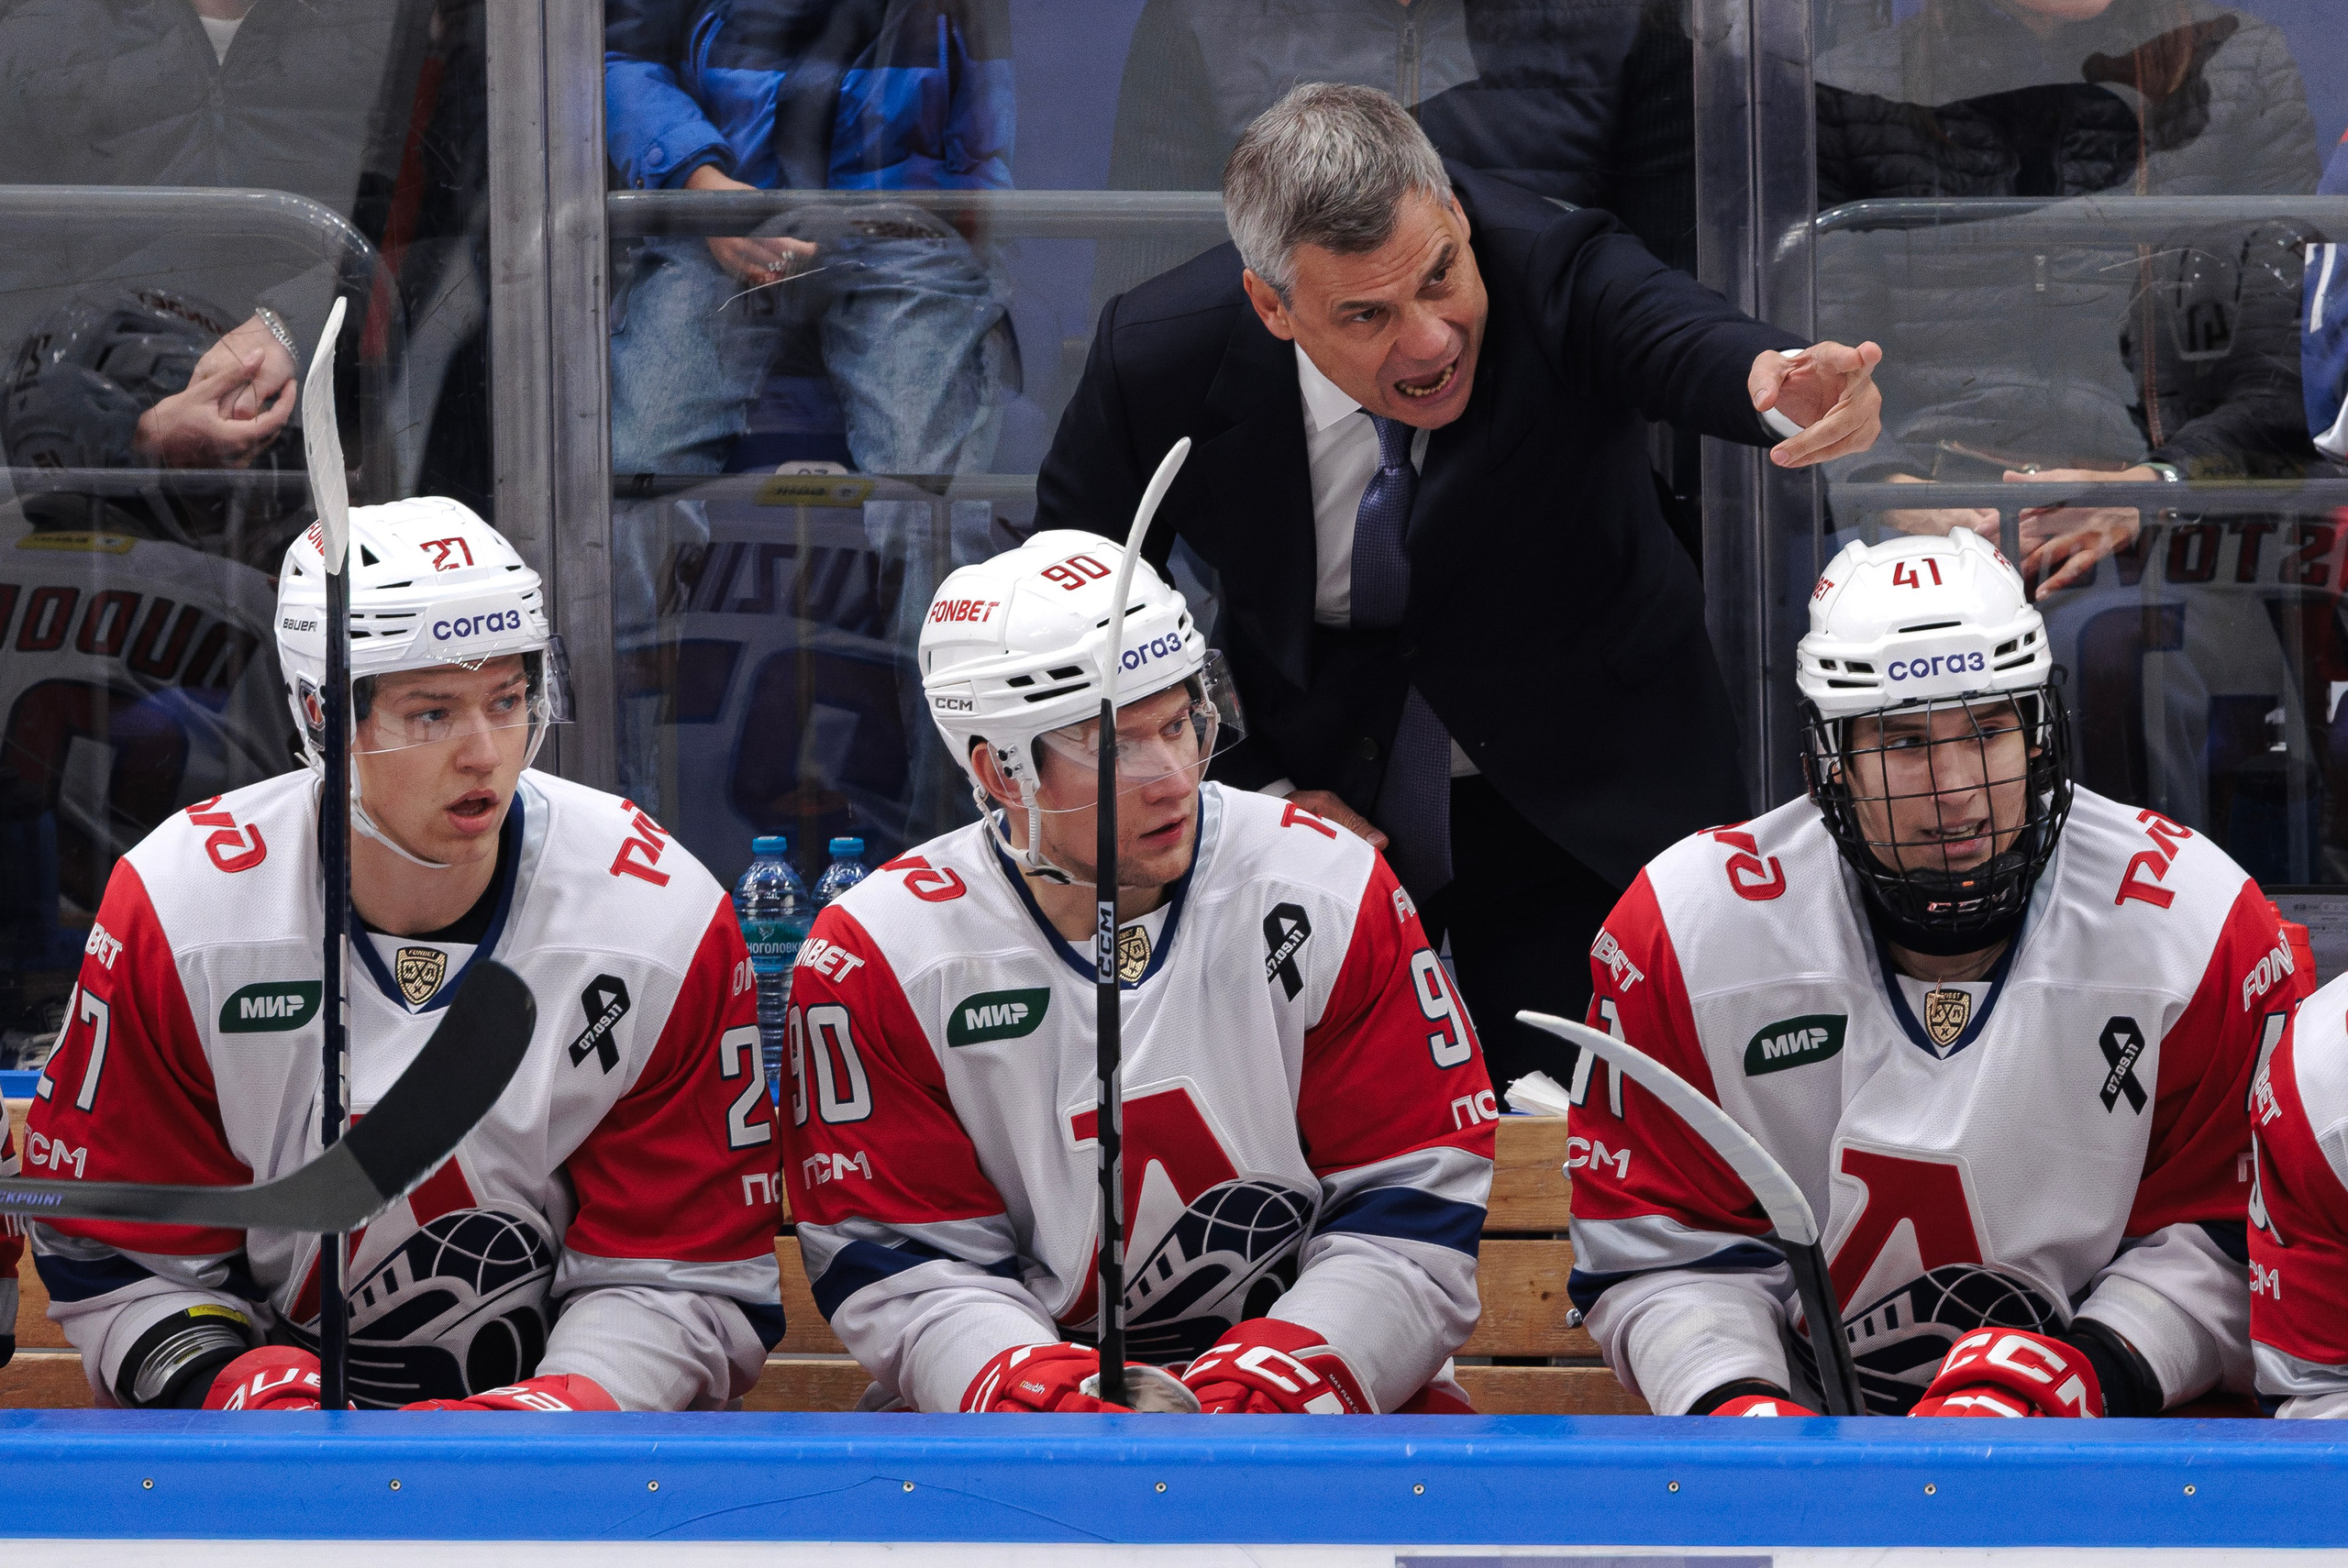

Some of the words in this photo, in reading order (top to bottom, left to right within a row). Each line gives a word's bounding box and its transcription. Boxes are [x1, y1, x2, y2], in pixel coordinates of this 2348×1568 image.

[419, 536, 474, 571] 27
[1041, 555, 1112, 591] 90
[1892, 558, 1943, 589] 41
[928, 599, 1000, 624] FONBET
[1117, 632, 1182, 675] огаз
[935, 697, 973, 712] CCM
[408, 949, 438, 957] FONBET
[1100, 907, 1113, 978] CCM
[240, 994, 305, 1019] МИР
[964, 1002, 1029, 1031] МИР
[1410, 947, 1482, 1070] 9
[578, 1003, 624, 1051] 07.09.11
[1761, 1027, 1829, 1060] МИР
[789, 1001, 872, 1128] 90
[2106, 1043, 2139, 1095] 07.09.11
[2254, 1061, 2282, 1127] BET
